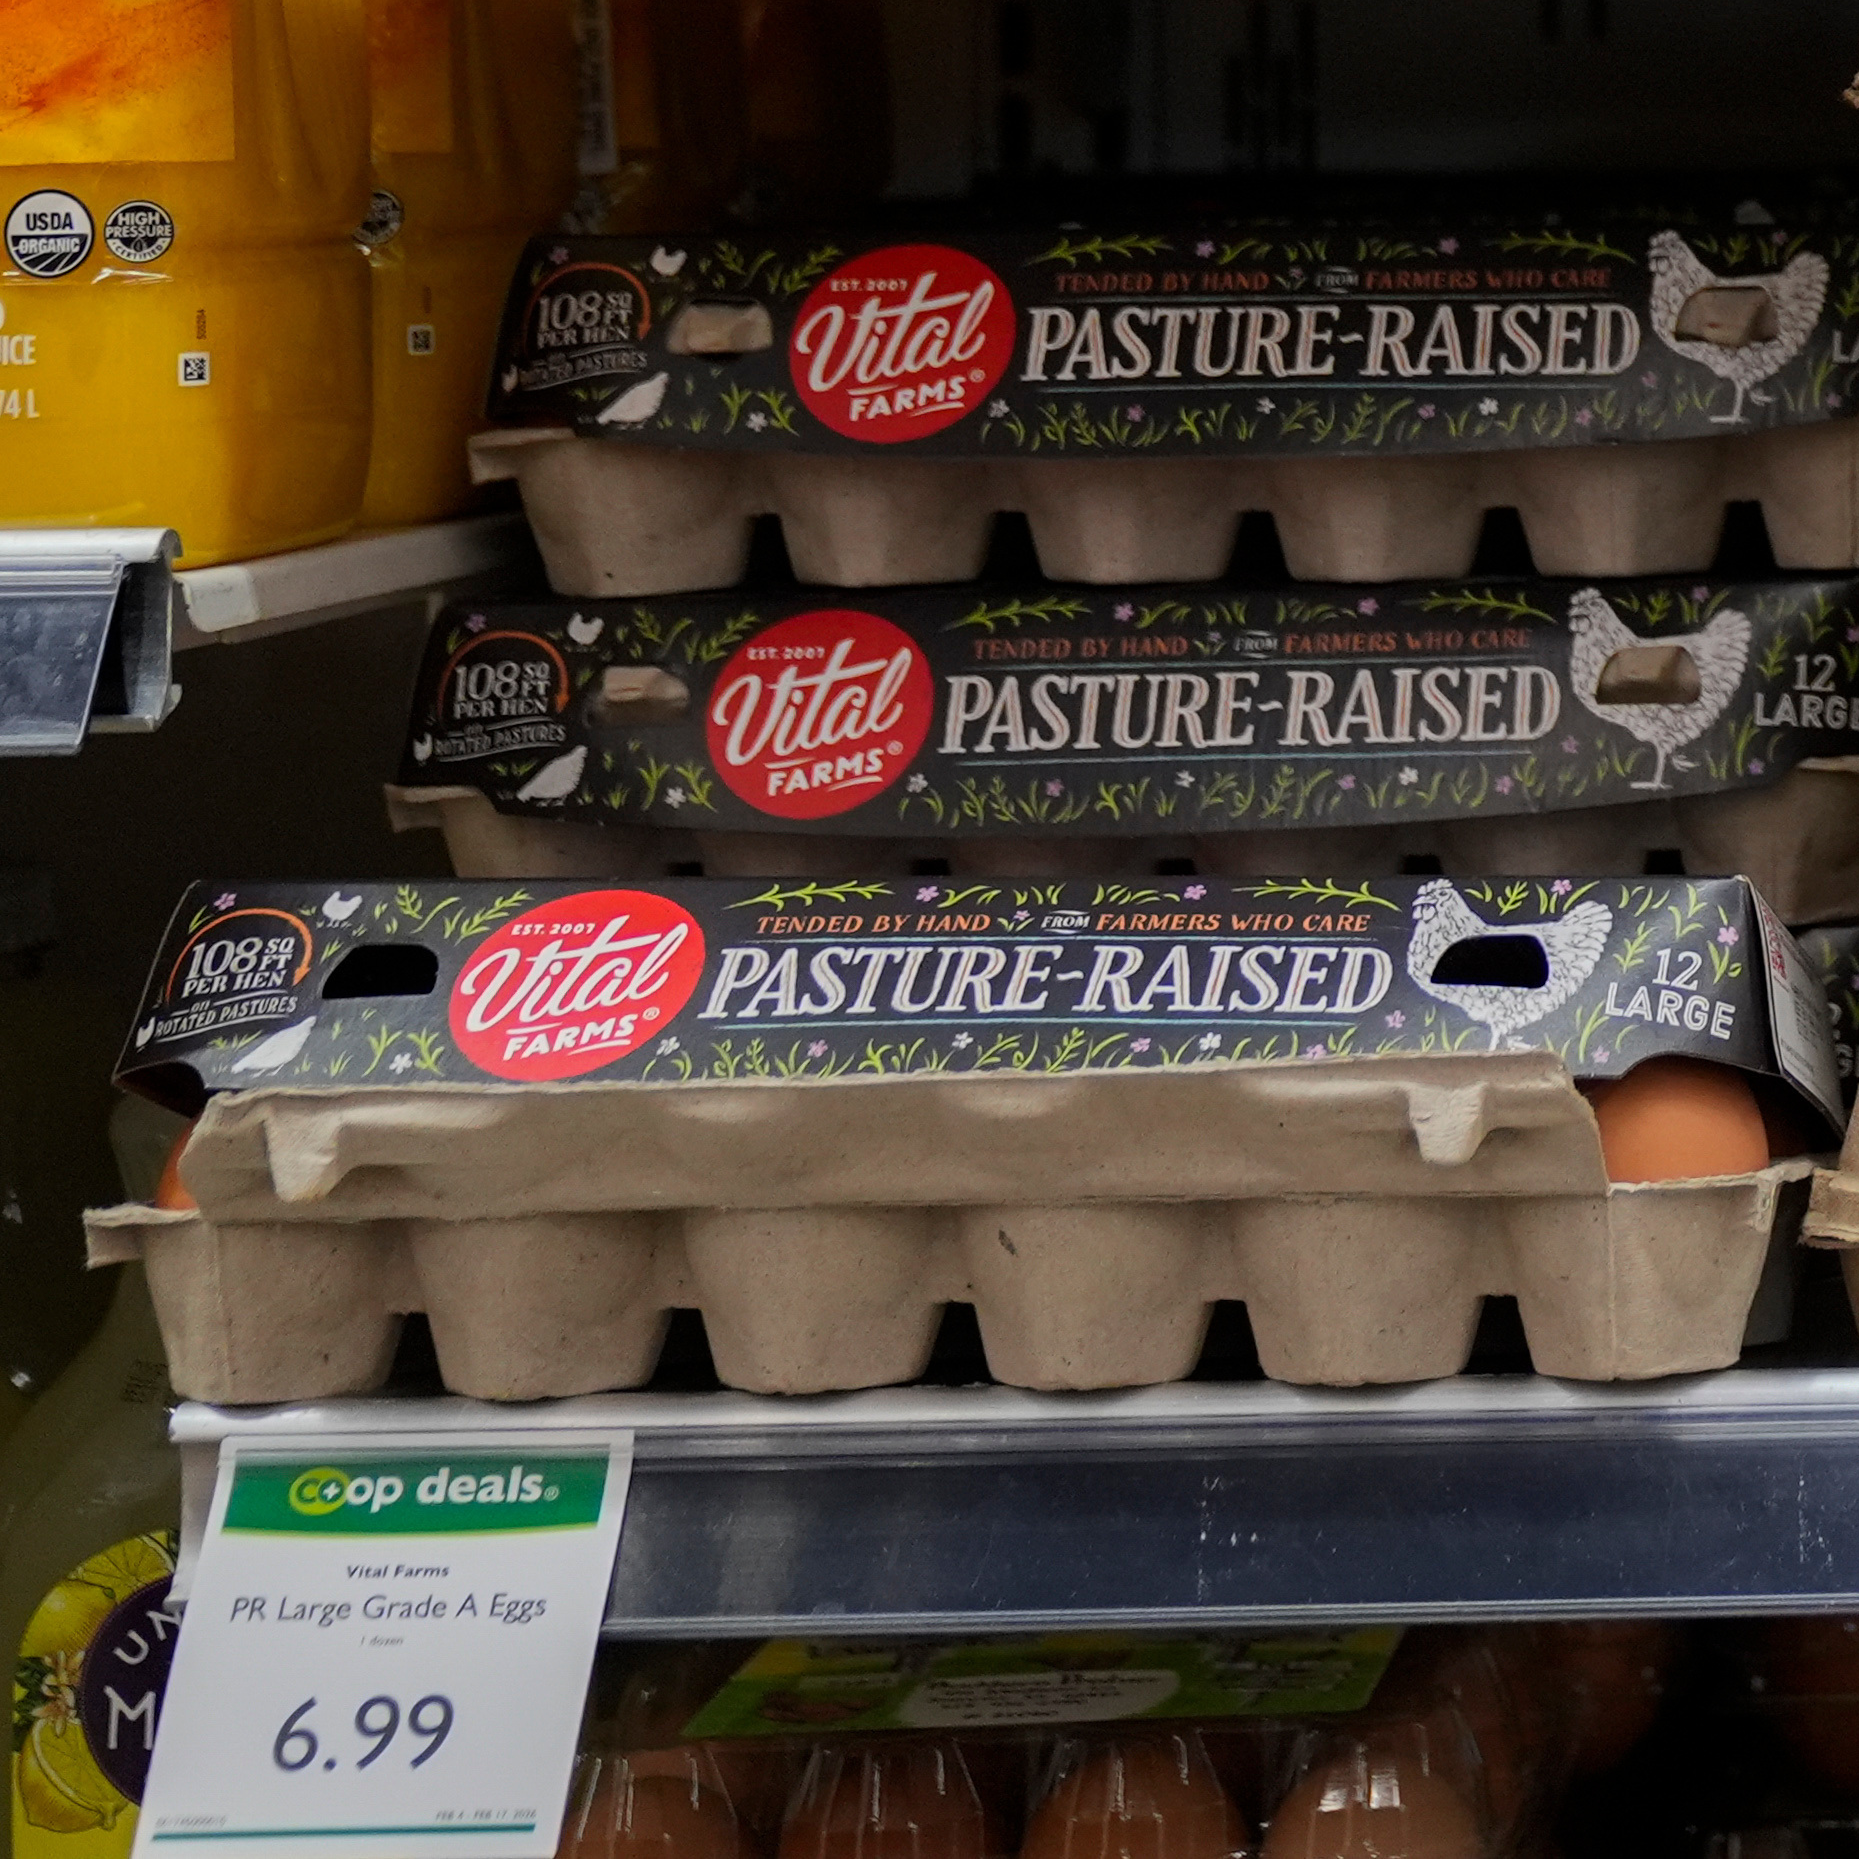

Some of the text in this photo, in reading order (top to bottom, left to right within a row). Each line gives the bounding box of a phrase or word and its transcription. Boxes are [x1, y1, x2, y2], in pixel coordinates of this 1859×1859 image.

[25, 212, 74, 232] USDA
[105, 224, 173, 238] PRESSURE
[118, 212, 160, 225] HIGH
[19, 238, 81, 255] ORGANIC
[796, 270, 997, 392] Vital
[1020, 302, 1641, 382] PASTURE-RAISED
[848, 376, 966, 422] FARMS
[1795, 654, 1835, 694] 12
[712, 638, 913, 766] Vital
[937, 665, 1560, 754] PASTURE-RAISED
[756, 911, 1370, 937] TENDED HAND FROM FARMERS WHO CARE
[186, 938, 257, 979] 108
[460, 915, 689, 1033] Vital
[698, 941, 1394, 1020] PASTURE-RAISED
[1655, 947, 1701, 990] 12
[1605, 984, 1738, 1042] LARGE
[503, 1012, 637, 1061] FARMS
[230, 1593, 547, 1627] PR Large Grade A Eggs
[272, 1694, 455, 1773] 6.99
